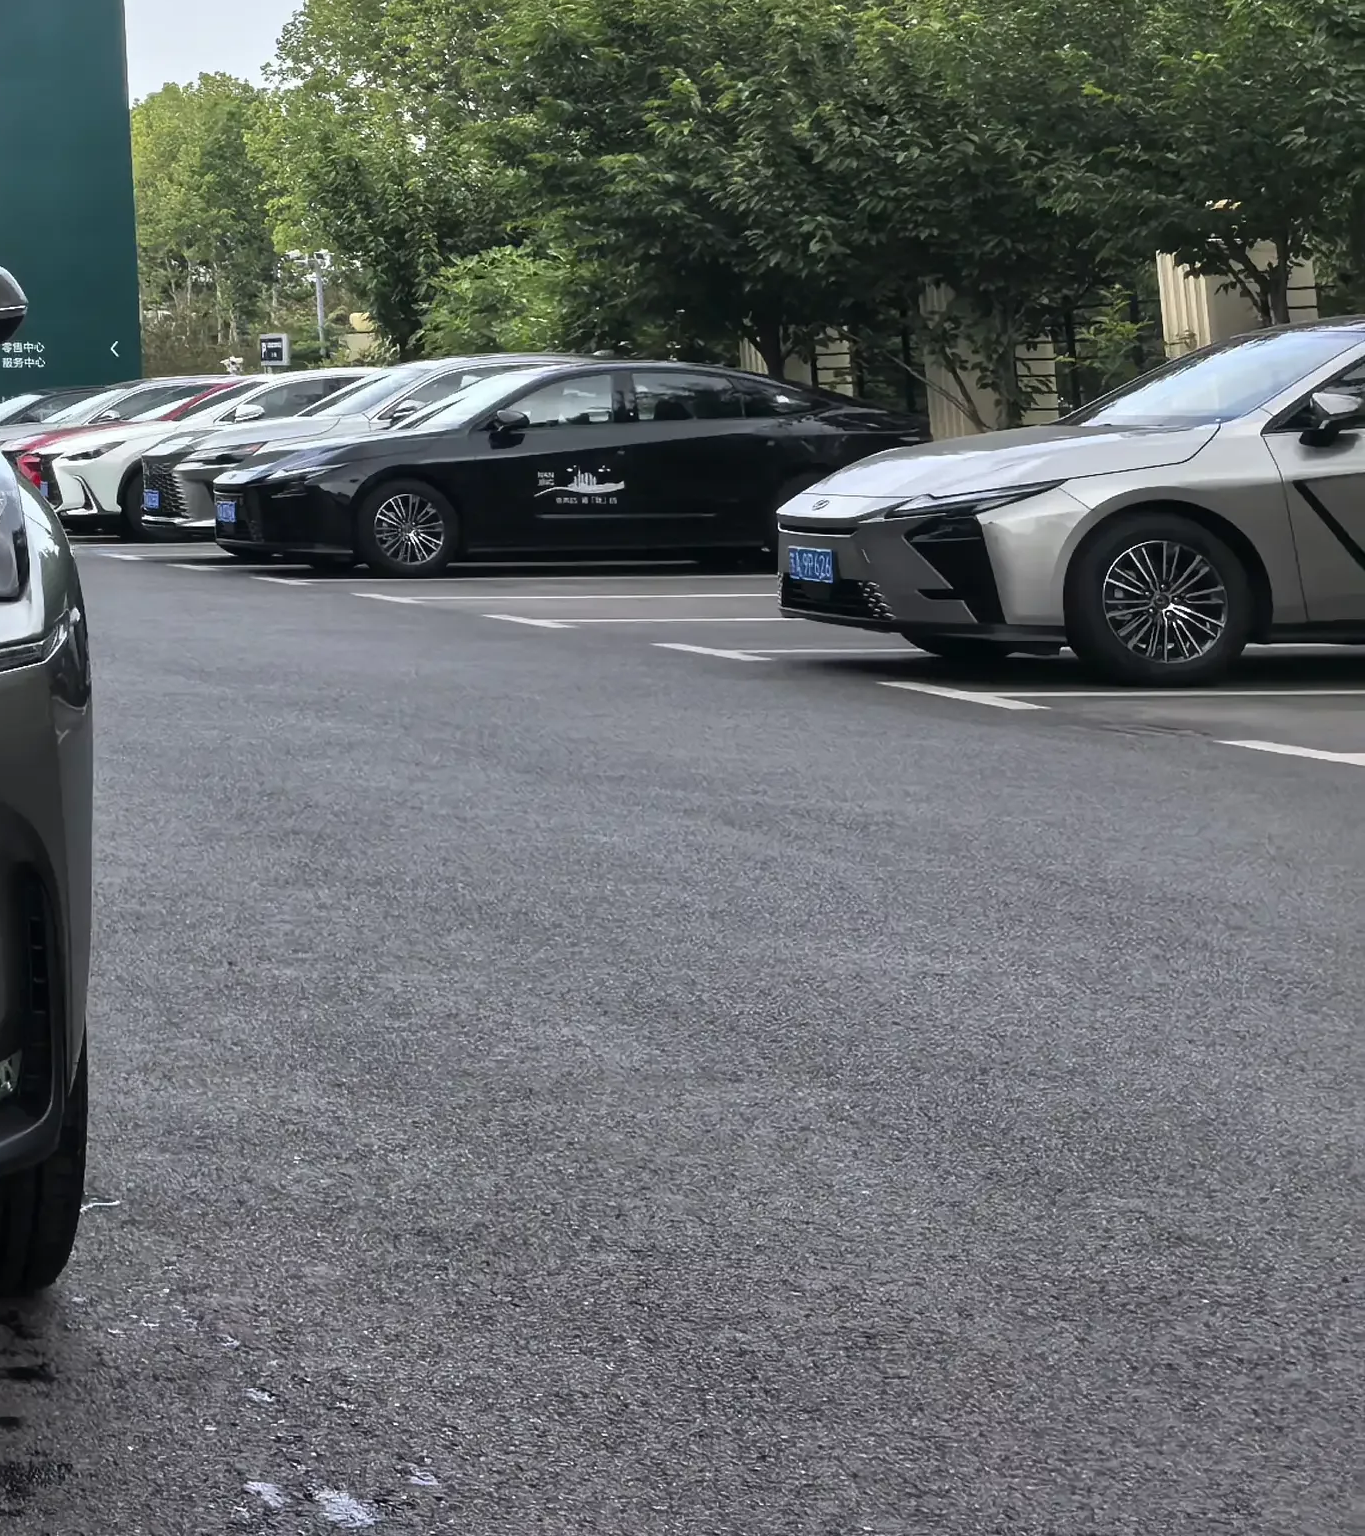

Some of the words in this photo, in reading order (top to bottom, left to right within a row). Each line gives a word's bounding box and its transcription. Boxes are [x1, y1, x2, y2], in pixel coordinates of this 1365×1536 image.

[1, 342, 45, 353] 零售中心
[2, 357, 46, 369] 服务中心
